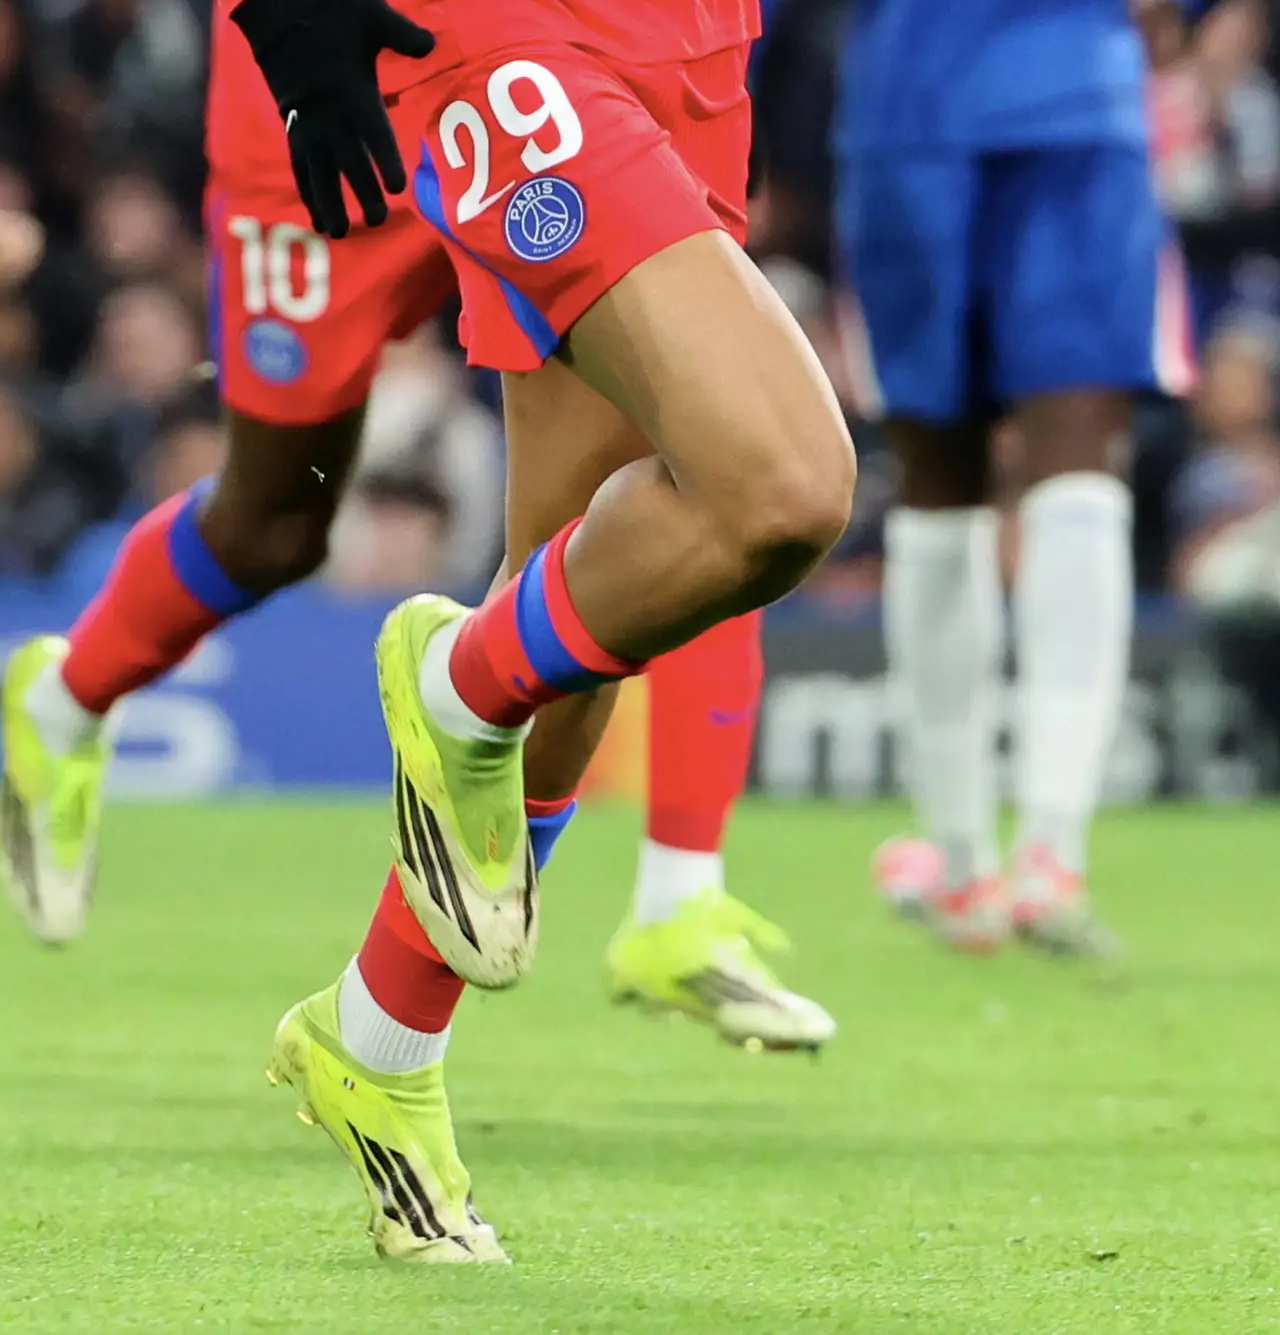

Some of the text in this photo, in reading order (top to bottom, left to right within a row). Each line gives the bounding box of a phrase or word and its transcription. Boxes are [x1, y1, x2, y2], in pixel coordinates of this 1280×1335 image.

[439, 59, 584, 225] 29
[510, 181, 554, 221] PARIS
[227, 214, 331, 323] 10
